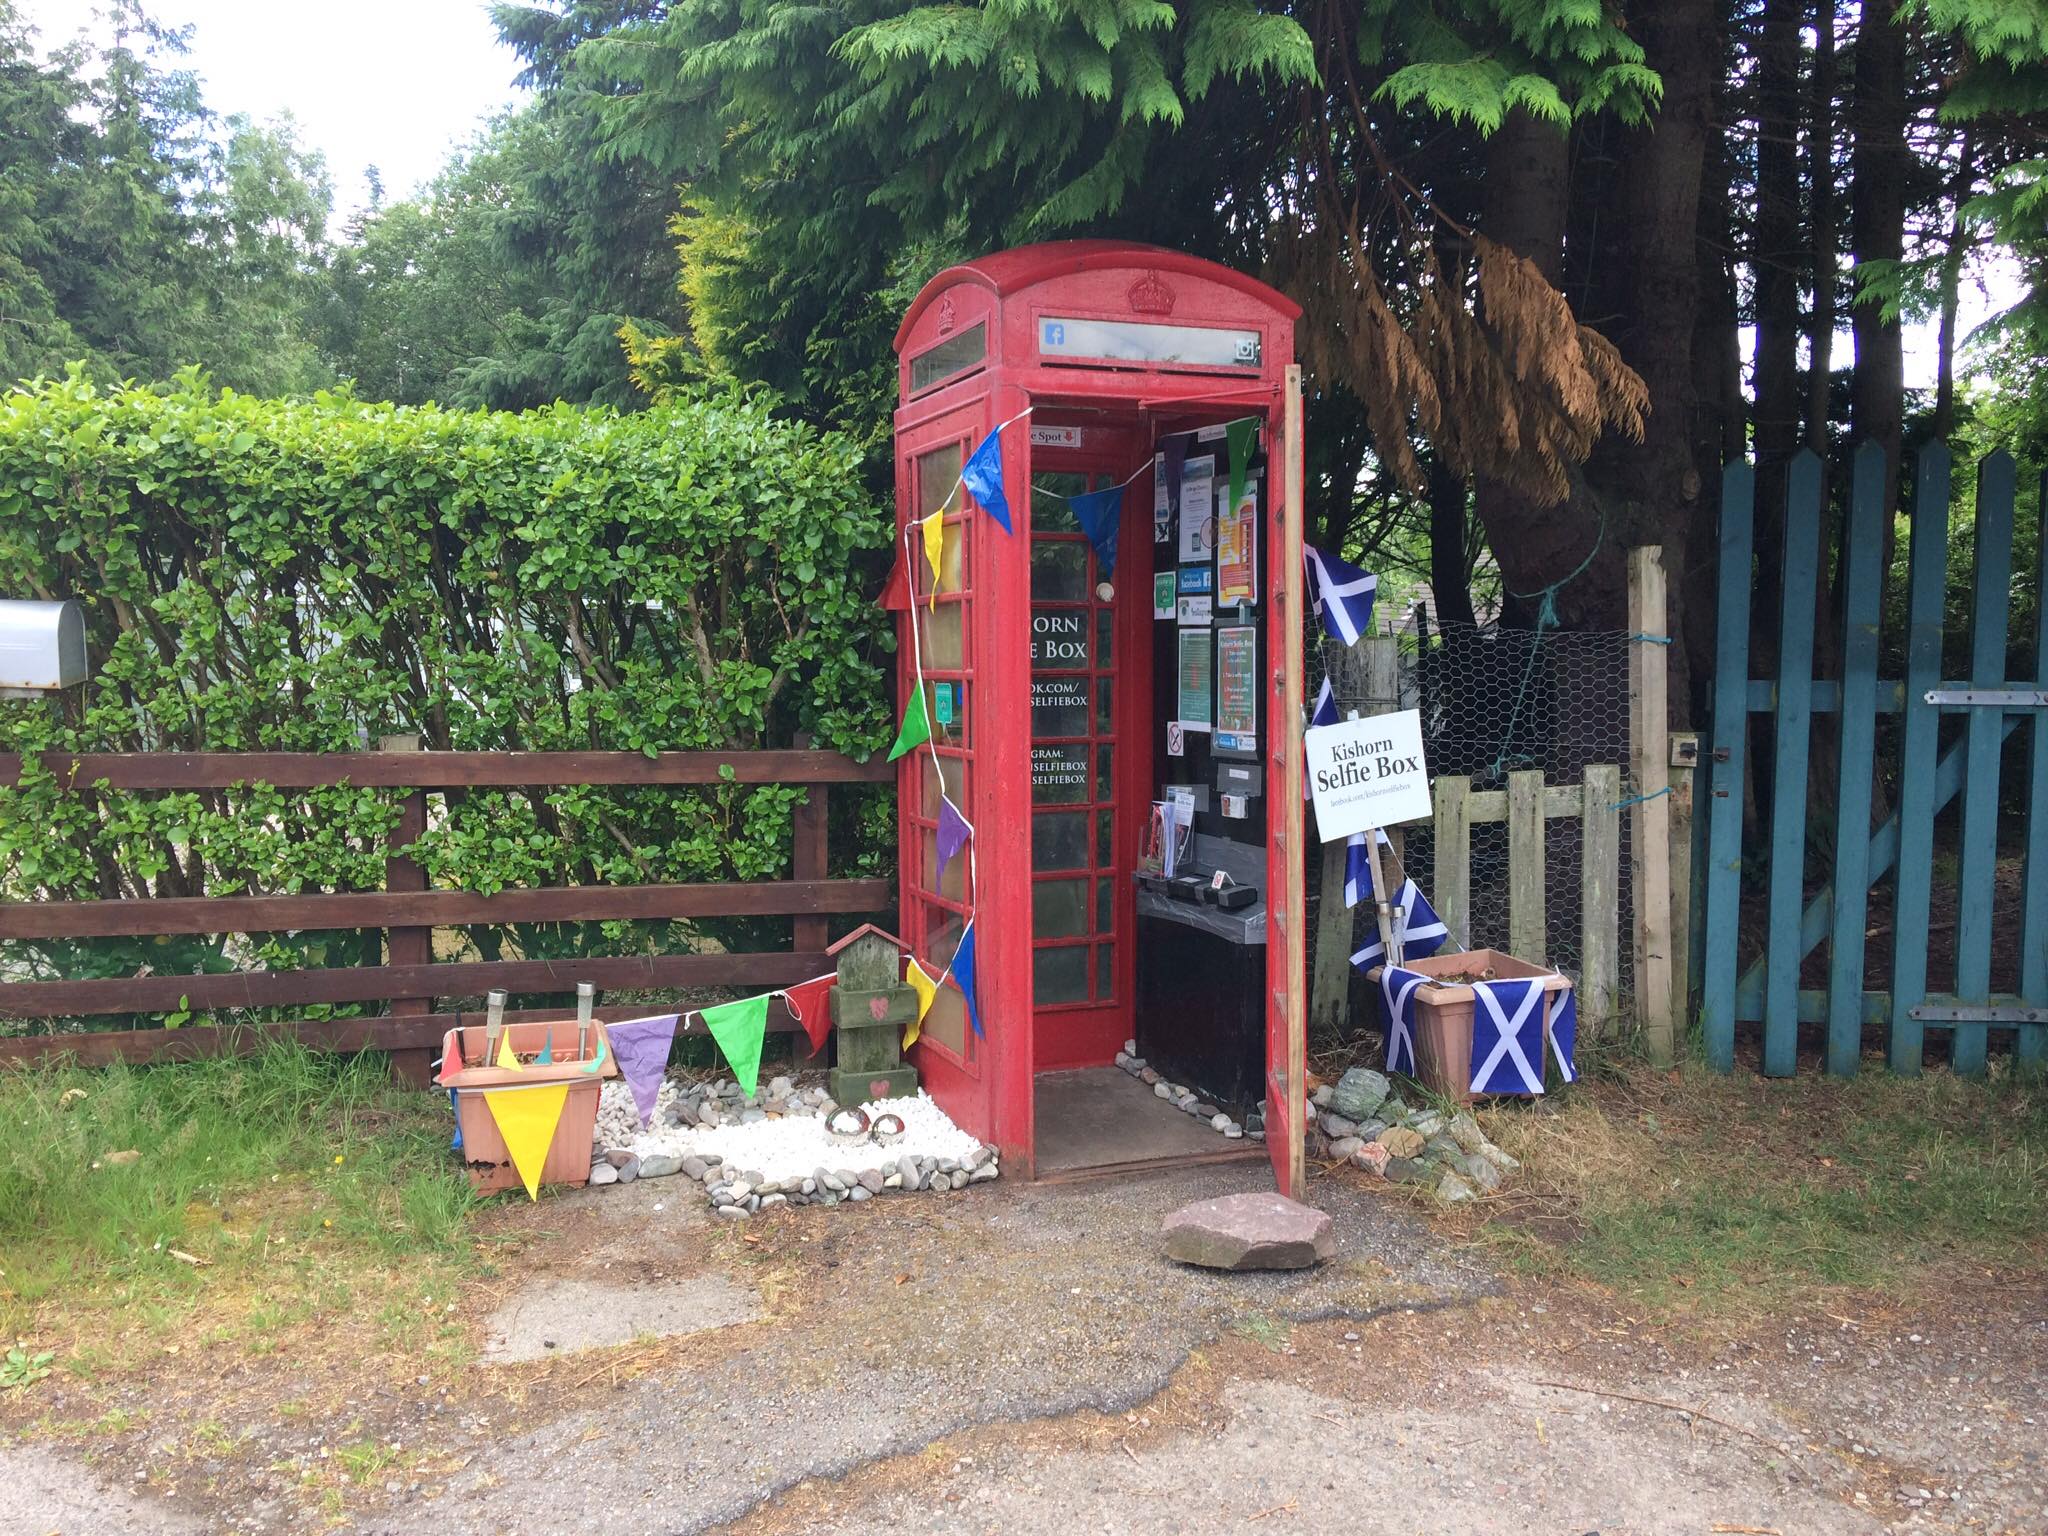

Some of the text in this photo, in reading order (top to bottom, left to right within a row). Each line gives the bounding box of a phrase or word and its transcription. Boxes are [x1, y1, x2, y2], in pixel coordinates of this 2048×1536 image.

[1038, 431, 1062, 443] Spot
[1032, 617, 1079, 633] ORN
[1030, 749, 1064, 759] GRAM:
[1331, 739, 1394, 762] Kishorn
[1030, 761, 1088, 772] SELFIEBOX
[1032, 774, 1086, 785] SELFIEBOX
[1317, 756, 1420, 793] Selfie Box
